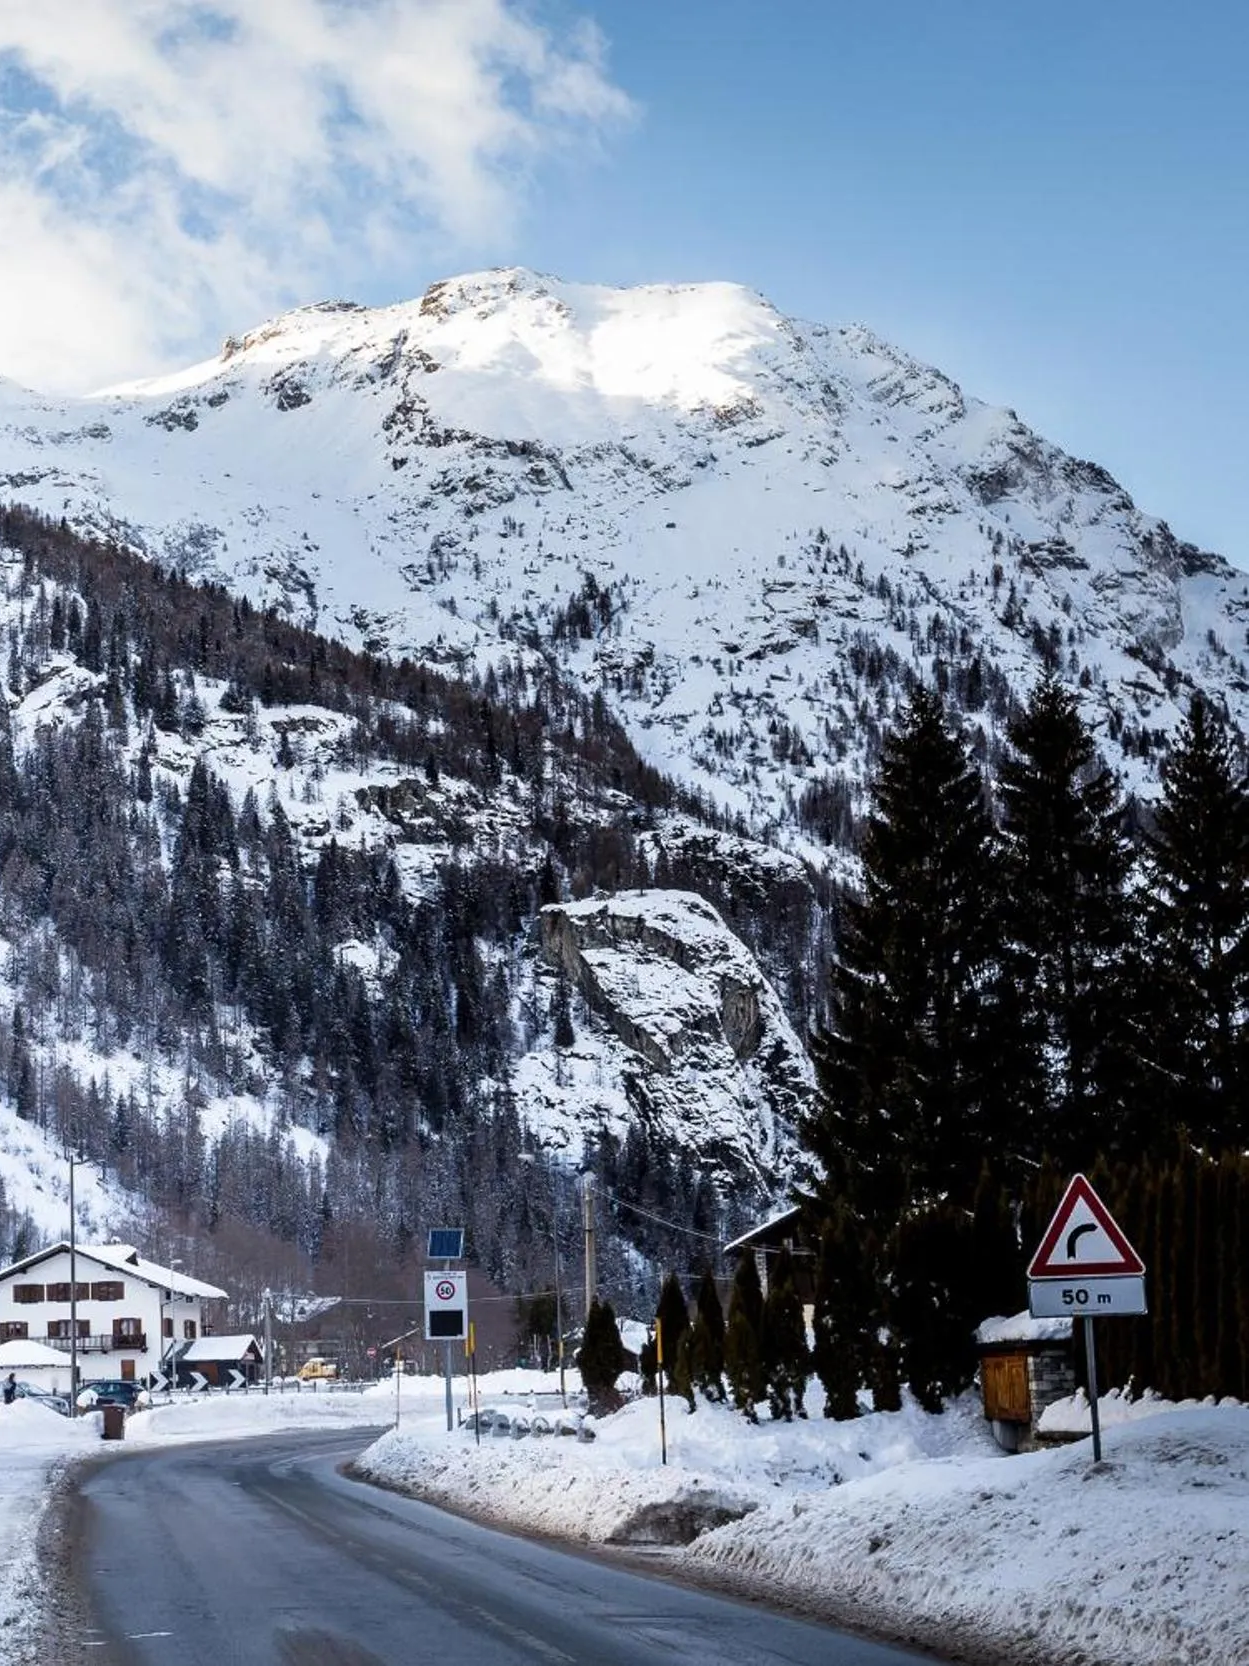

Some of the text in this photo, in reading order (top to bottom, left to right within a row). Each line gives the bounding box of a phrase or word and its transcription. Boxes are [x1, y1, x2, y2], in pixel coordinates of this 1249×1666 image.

[440, 1286, 451, 1295] 50
[1062, 1289, 1111, 1305] 50 m
